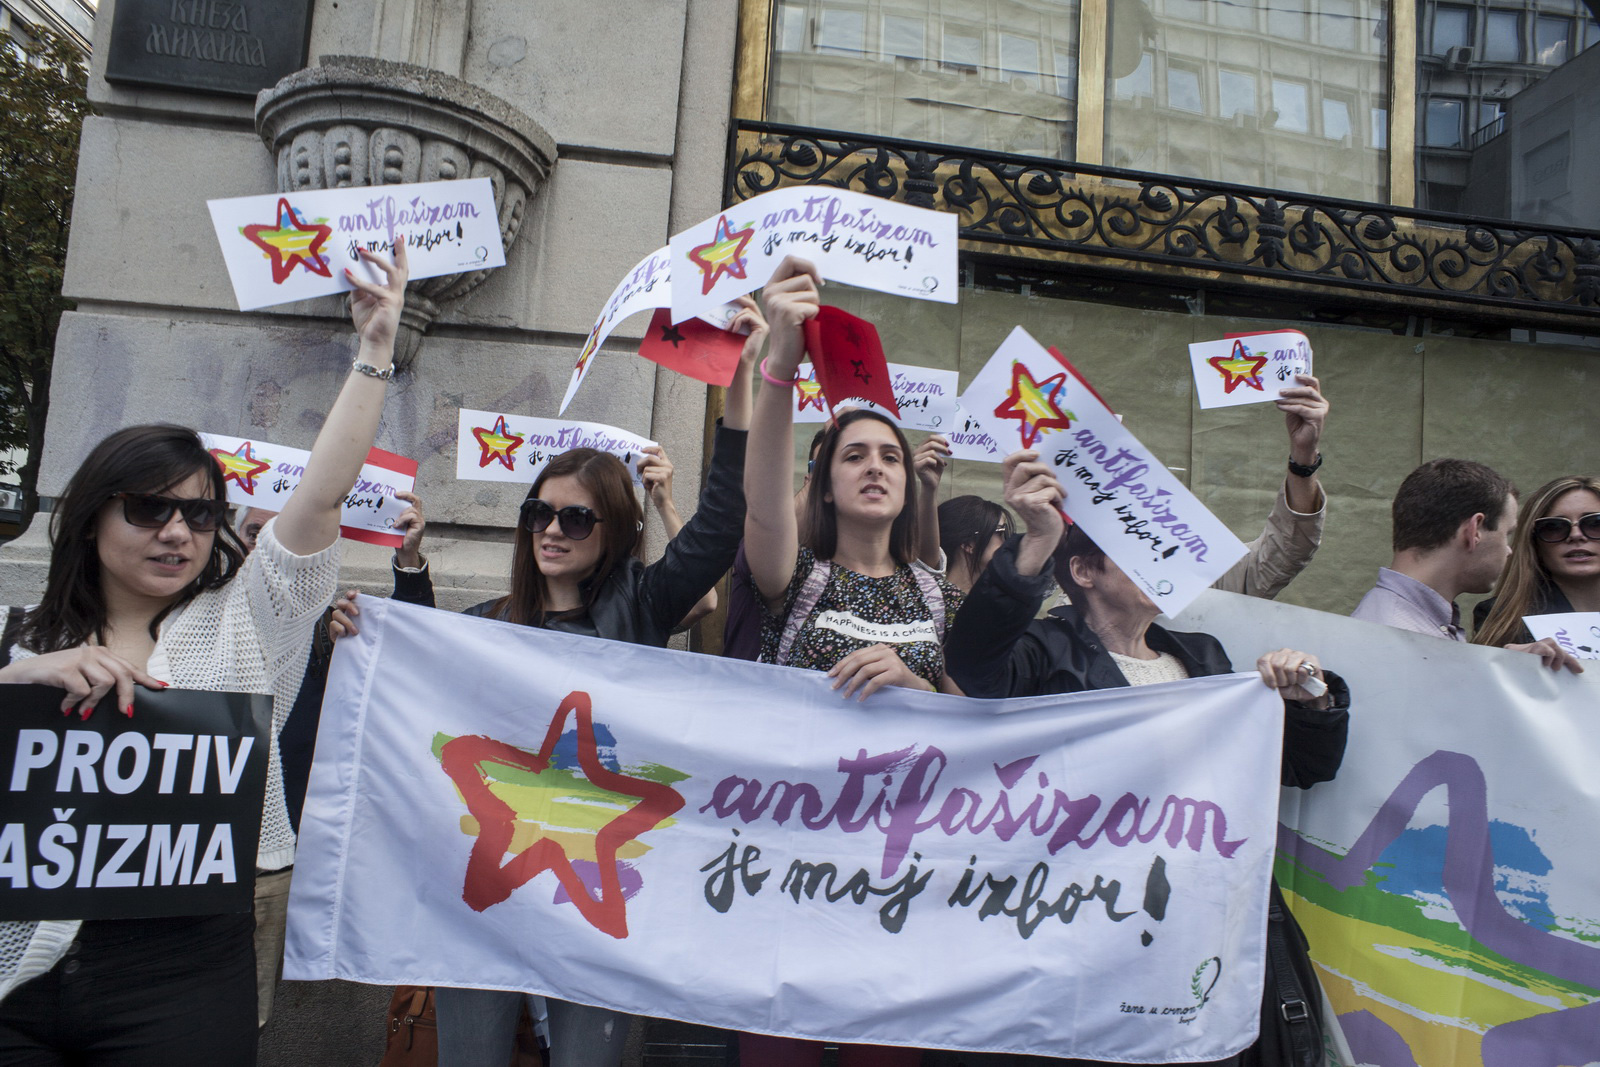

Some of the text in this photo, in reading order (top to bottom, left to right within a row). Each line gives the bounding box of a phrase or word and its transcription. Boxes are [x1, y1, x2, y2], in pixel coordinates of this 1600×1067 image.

[337, 195, 480, 242] antifašizam
[408, 220, 463, 252] izbor!
[759, 195, 940, 249] antifašizam
[762, 229, 914, 270] je moj izbor!
[1276, 362, 1293, 381] je
[528, 447, 544, 466] je
[272, 475, 291, 494] je
[1053, 446, 1181, 562] je moj izbor!
[1071, 428, 1208, 563] antifašizam
[826, 616, 877, 636] HAPPINESS
[902, 626, 935, 637] CHOICE
[9, 729, 255, 795] PROTIV
[699, 742, 1249, 879] antifašizam
[0, 808, 237, 889] AŠIZMA
[699, 828, 1171, 947] je moj izbor!
[1120, 1002, 1146, 1014] žene
